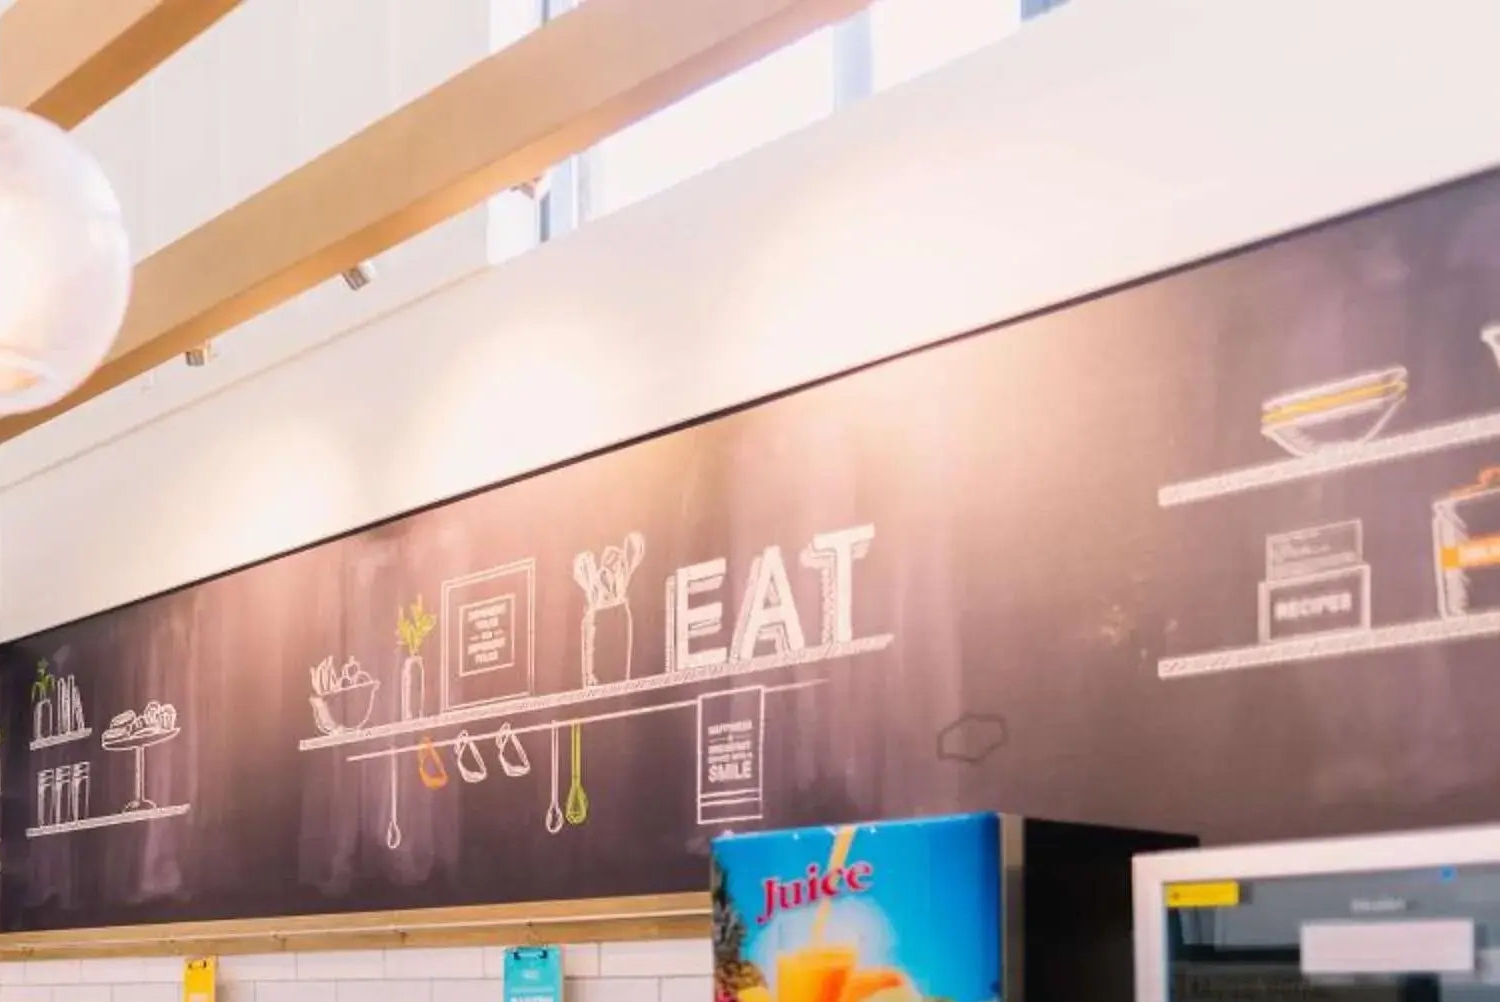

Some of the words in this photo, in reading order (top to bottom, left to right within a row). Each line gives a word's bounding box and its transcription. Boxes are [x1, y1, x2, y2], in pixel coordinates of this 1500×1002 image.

[666, 523, 875, 672] EAT
[707, 759, 753, 783] SMILE
[756, 860, 873, 924] Juice
